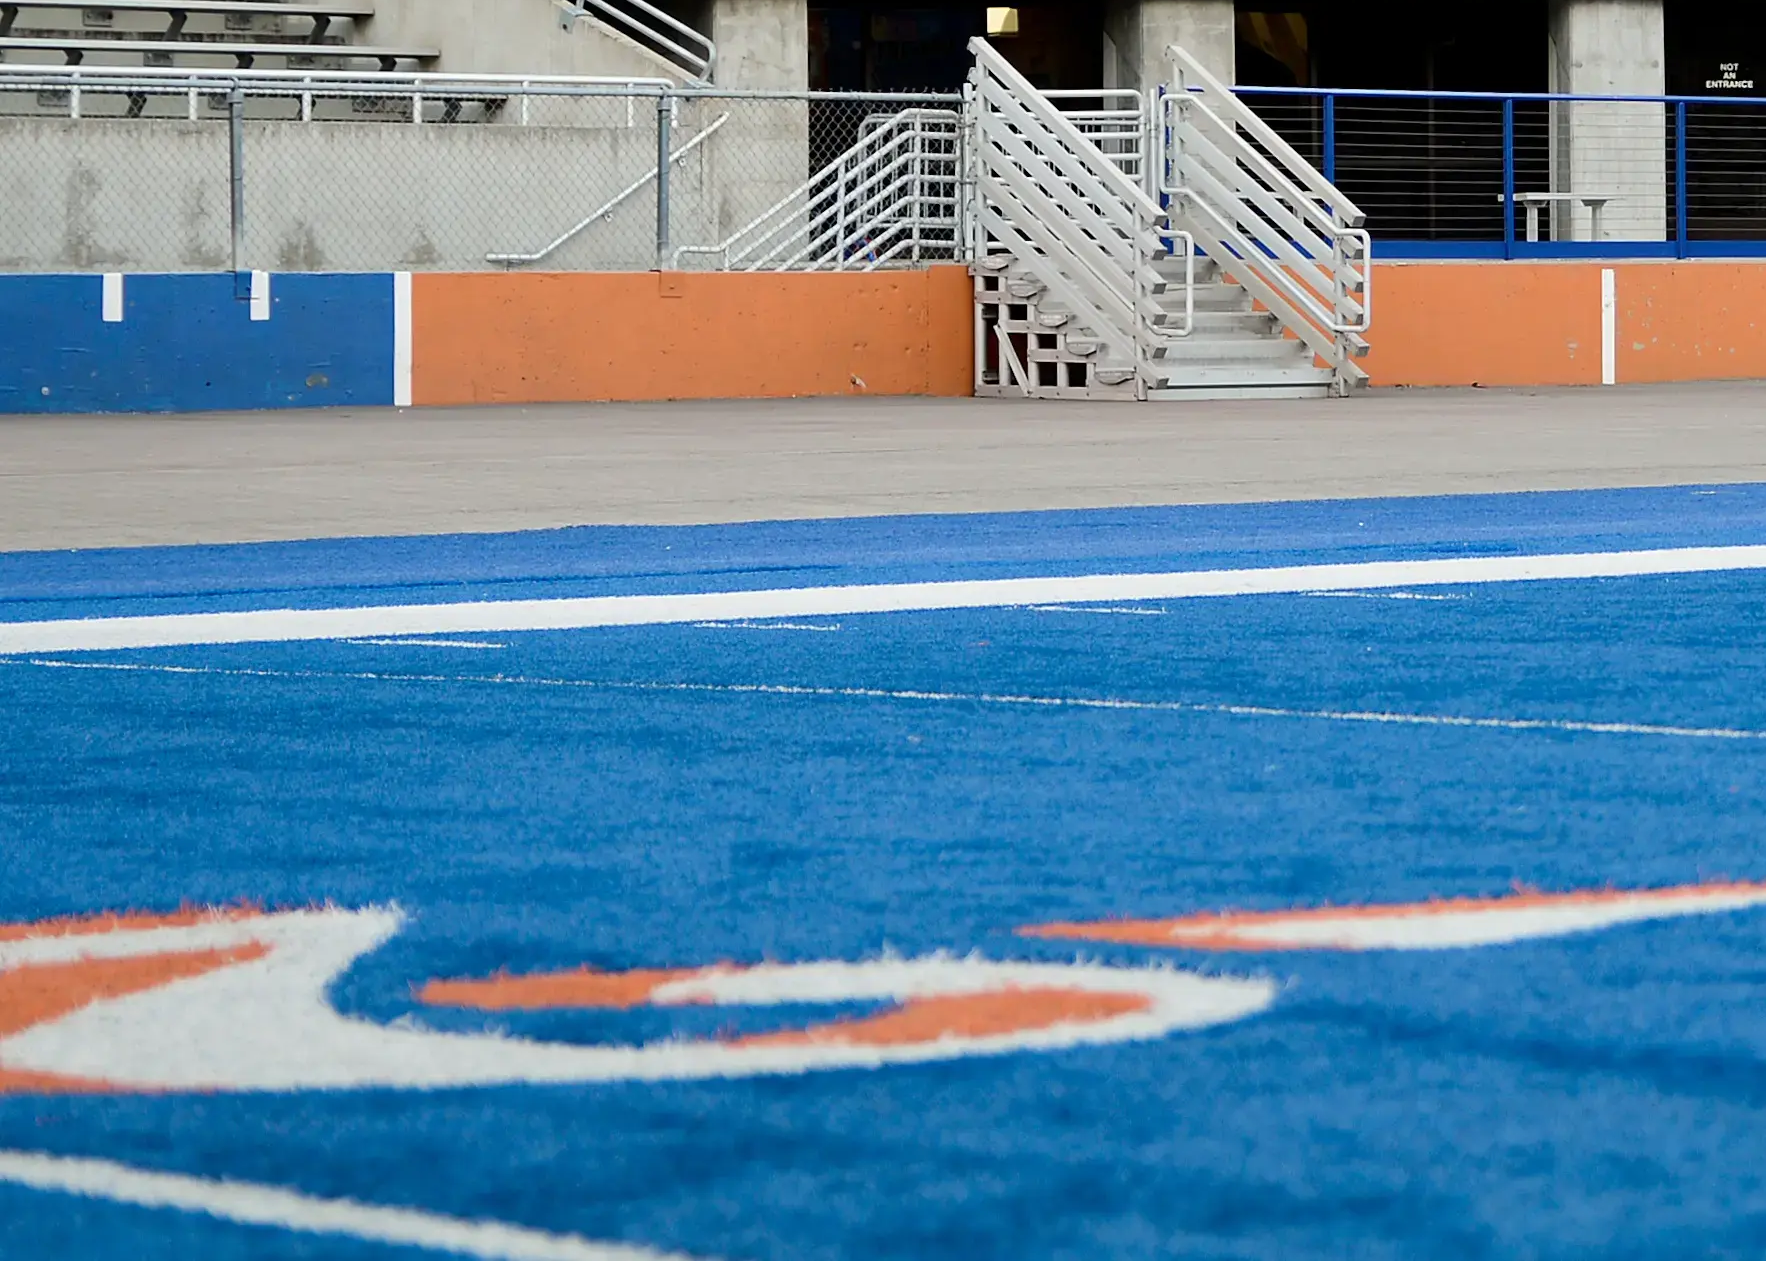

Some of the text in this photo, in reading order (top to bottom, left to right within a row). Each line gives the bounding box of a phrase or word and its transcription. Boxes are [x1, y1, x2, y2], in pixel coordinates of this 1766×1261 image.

[1719, 62, 1739, 71] NOT
[1722, 71, 1737, 80] AN
[1705, 80, 1754, 89] ENTRANCE
